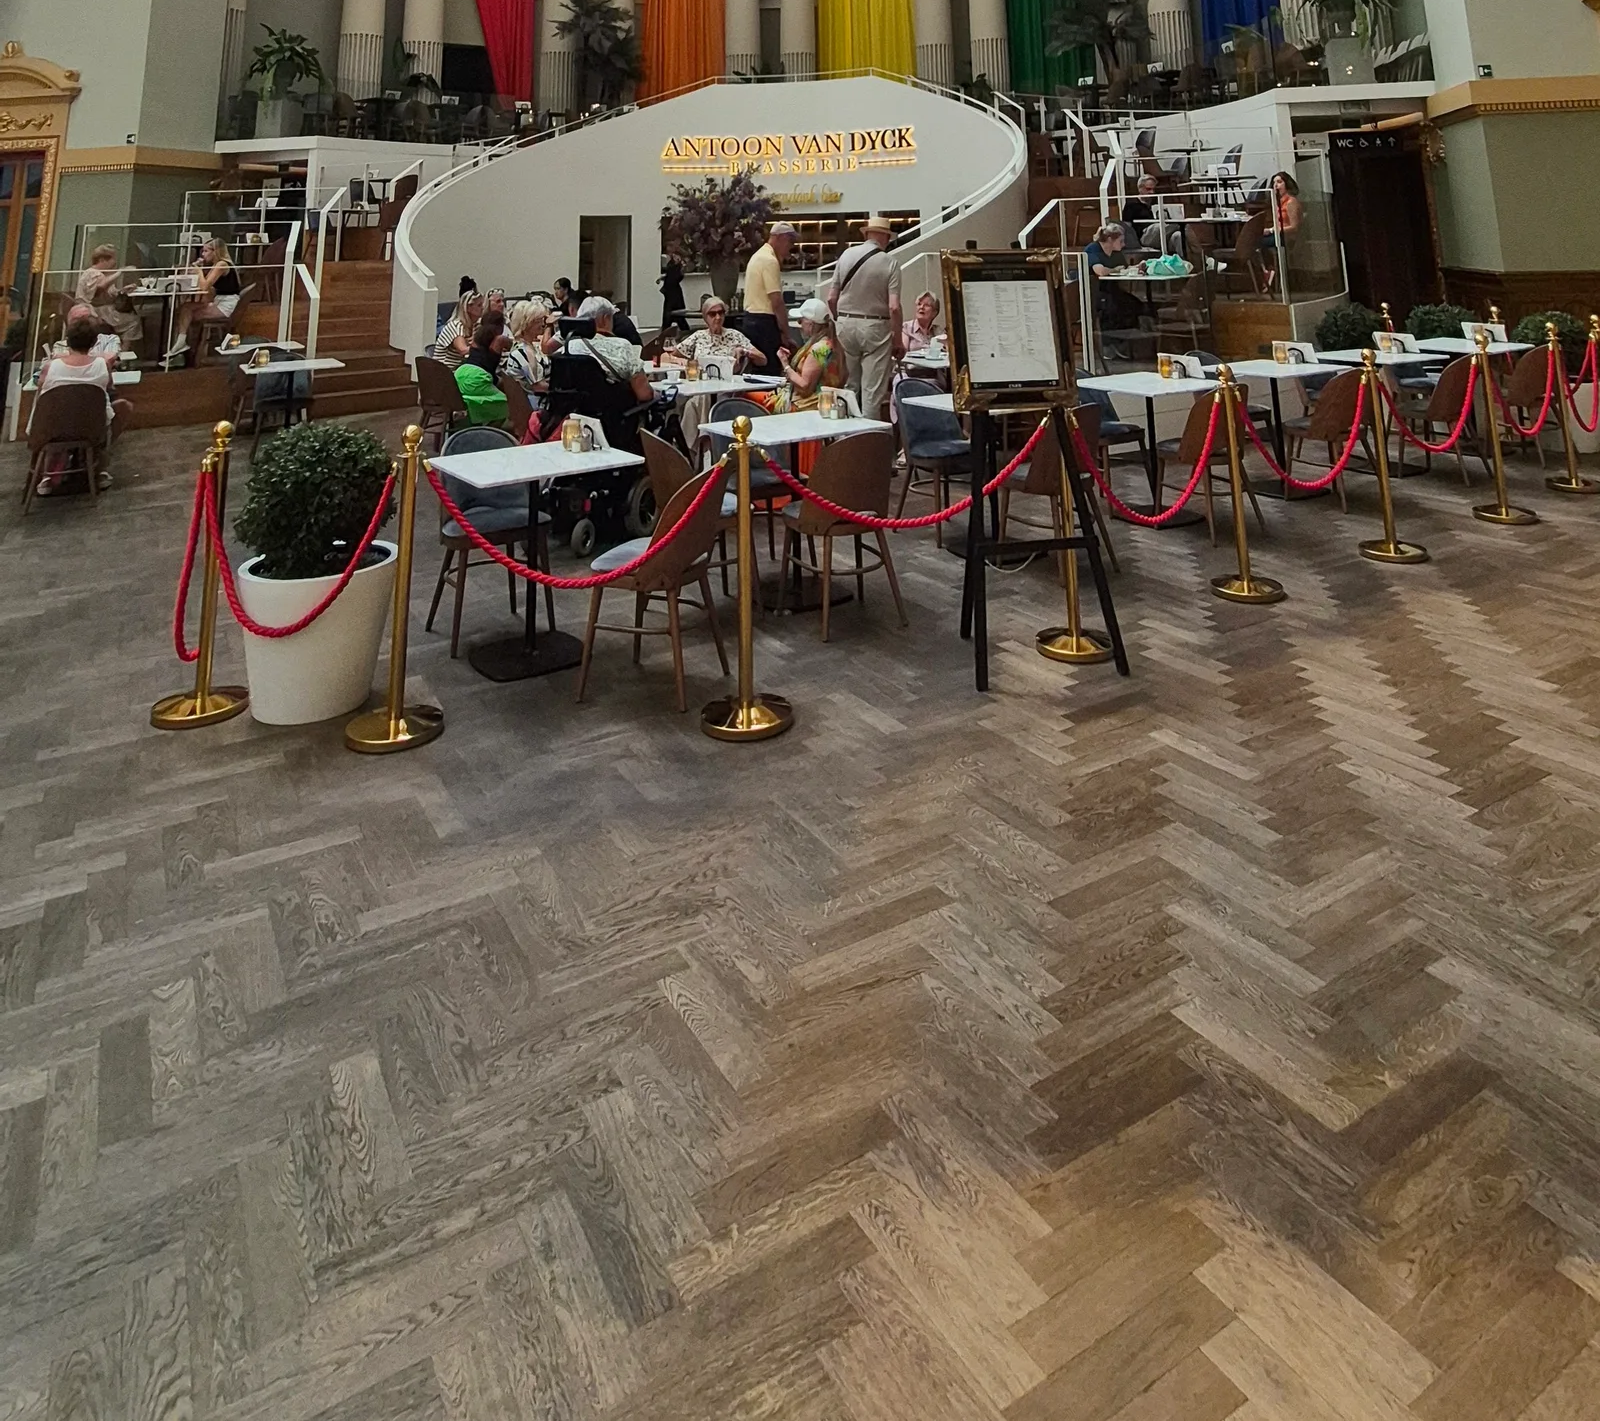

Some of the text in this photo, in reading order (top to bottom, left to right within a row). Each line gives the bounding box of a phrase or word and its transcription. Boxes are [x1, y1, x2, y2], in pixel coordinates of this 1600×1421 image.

[664, 126, 914, 157] ANTOON VAN DYCK
[1336, 138, 1354, 148] WC
[730, 157, 857, 174] BRASSERIE
